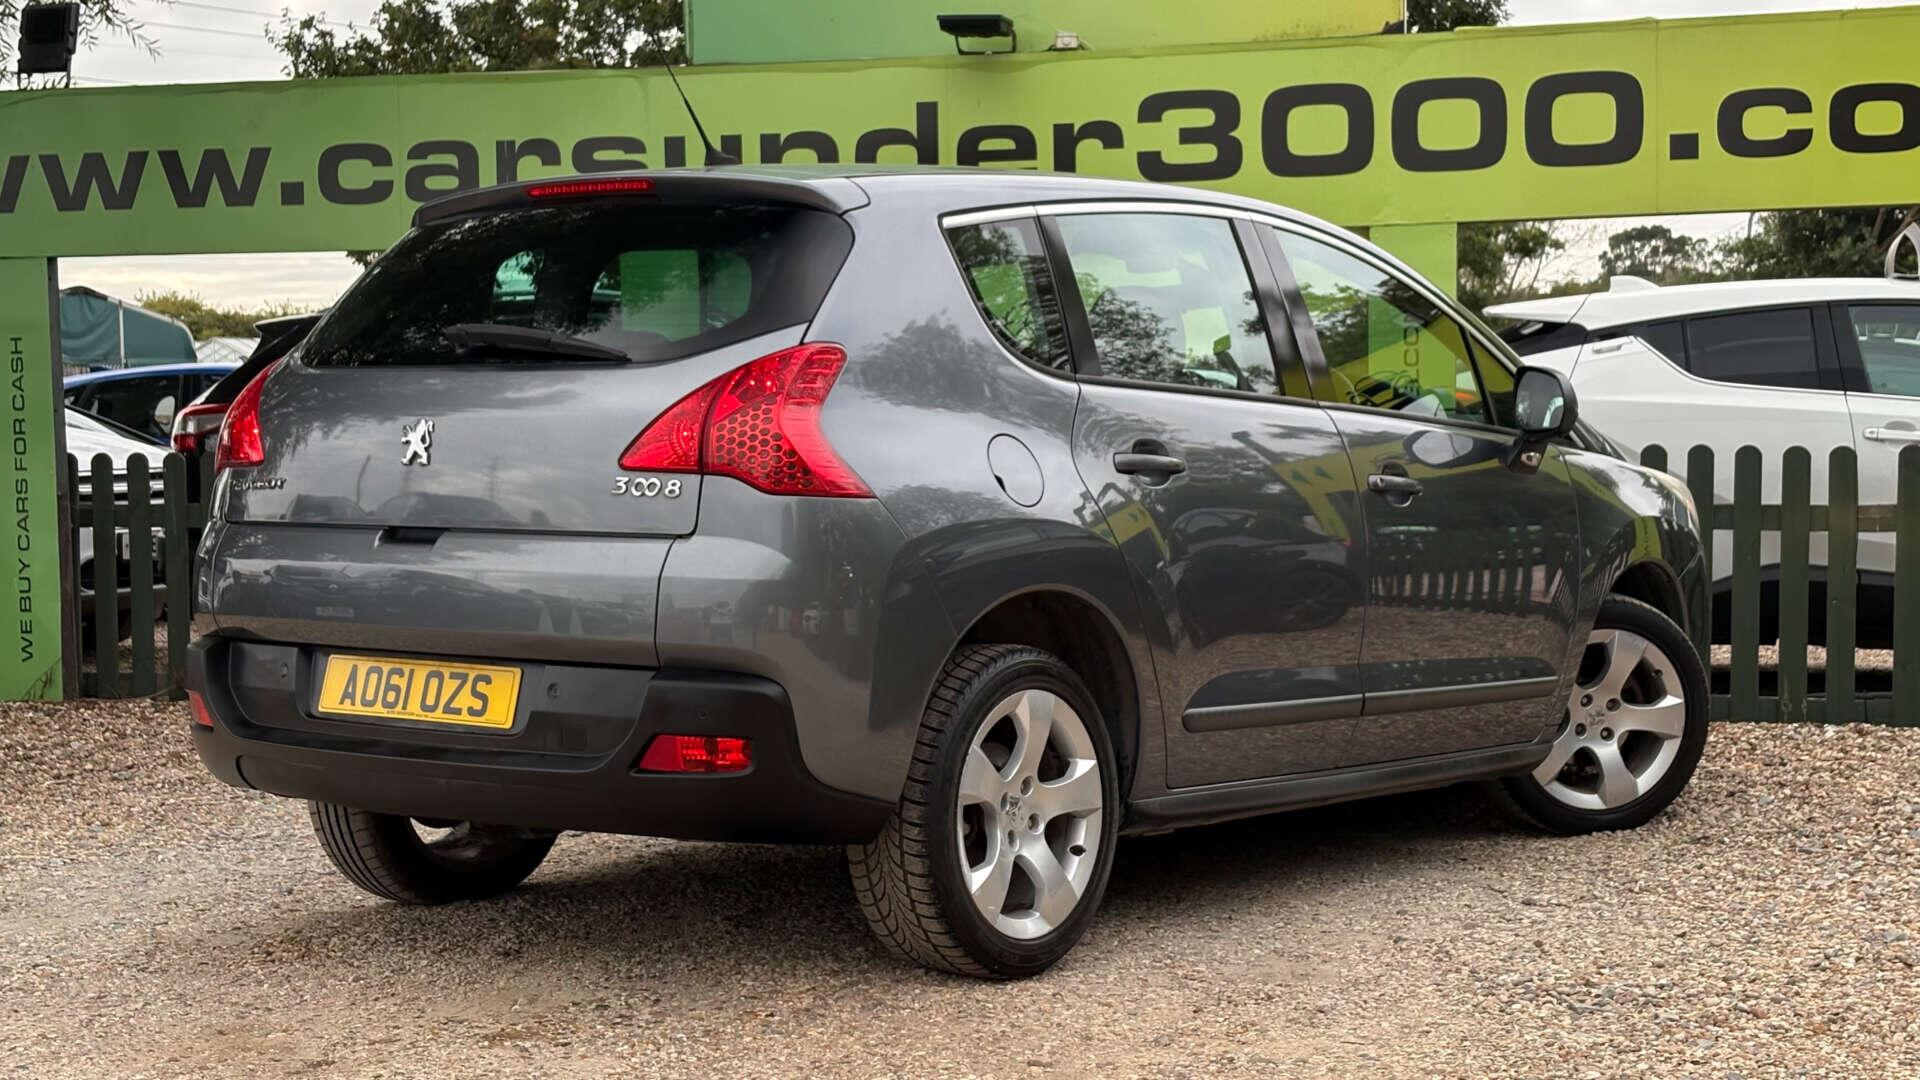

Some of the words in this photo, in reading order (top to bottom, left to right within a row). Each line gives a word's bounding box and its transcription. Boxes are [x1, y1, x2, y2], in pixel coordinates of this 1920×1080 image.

[10, 336, 26, 412] CASH
[13, 418, 28, 471] FOR
[15, 478, 31, 551] CARS
[611, 476, 682, 498] 3008
[18, 557, 32, 613] BUY
[20, 619, 34, 662] WE
[338, 663, 415, 711] AO61
[419, 669, 493, 718] OZS
